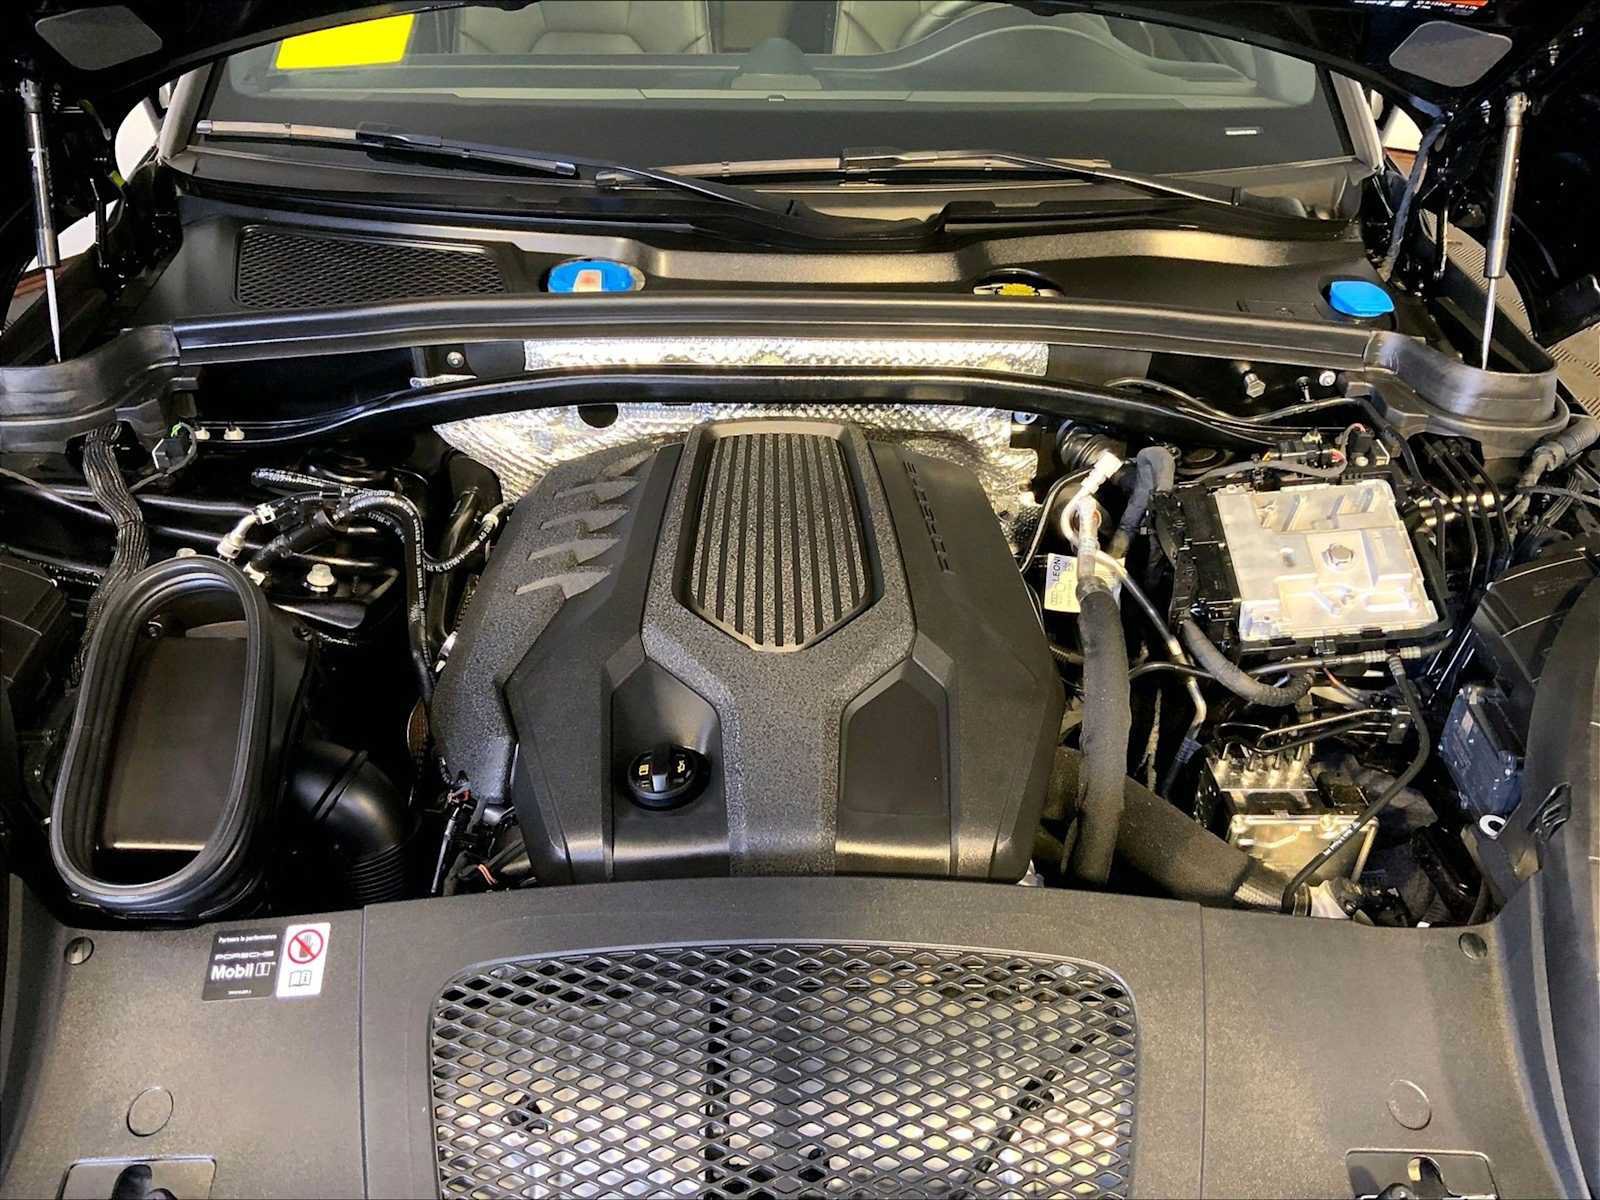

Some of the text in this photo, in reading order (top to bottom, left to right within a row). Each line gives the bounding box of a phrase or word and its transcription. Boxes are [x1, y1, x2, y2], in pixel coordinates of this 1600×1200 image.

[1051, 556, 1061, 582] LEONI
[215, 951, 274, 960] PORSCHE
[211, 963, 254, 980] Mobil
